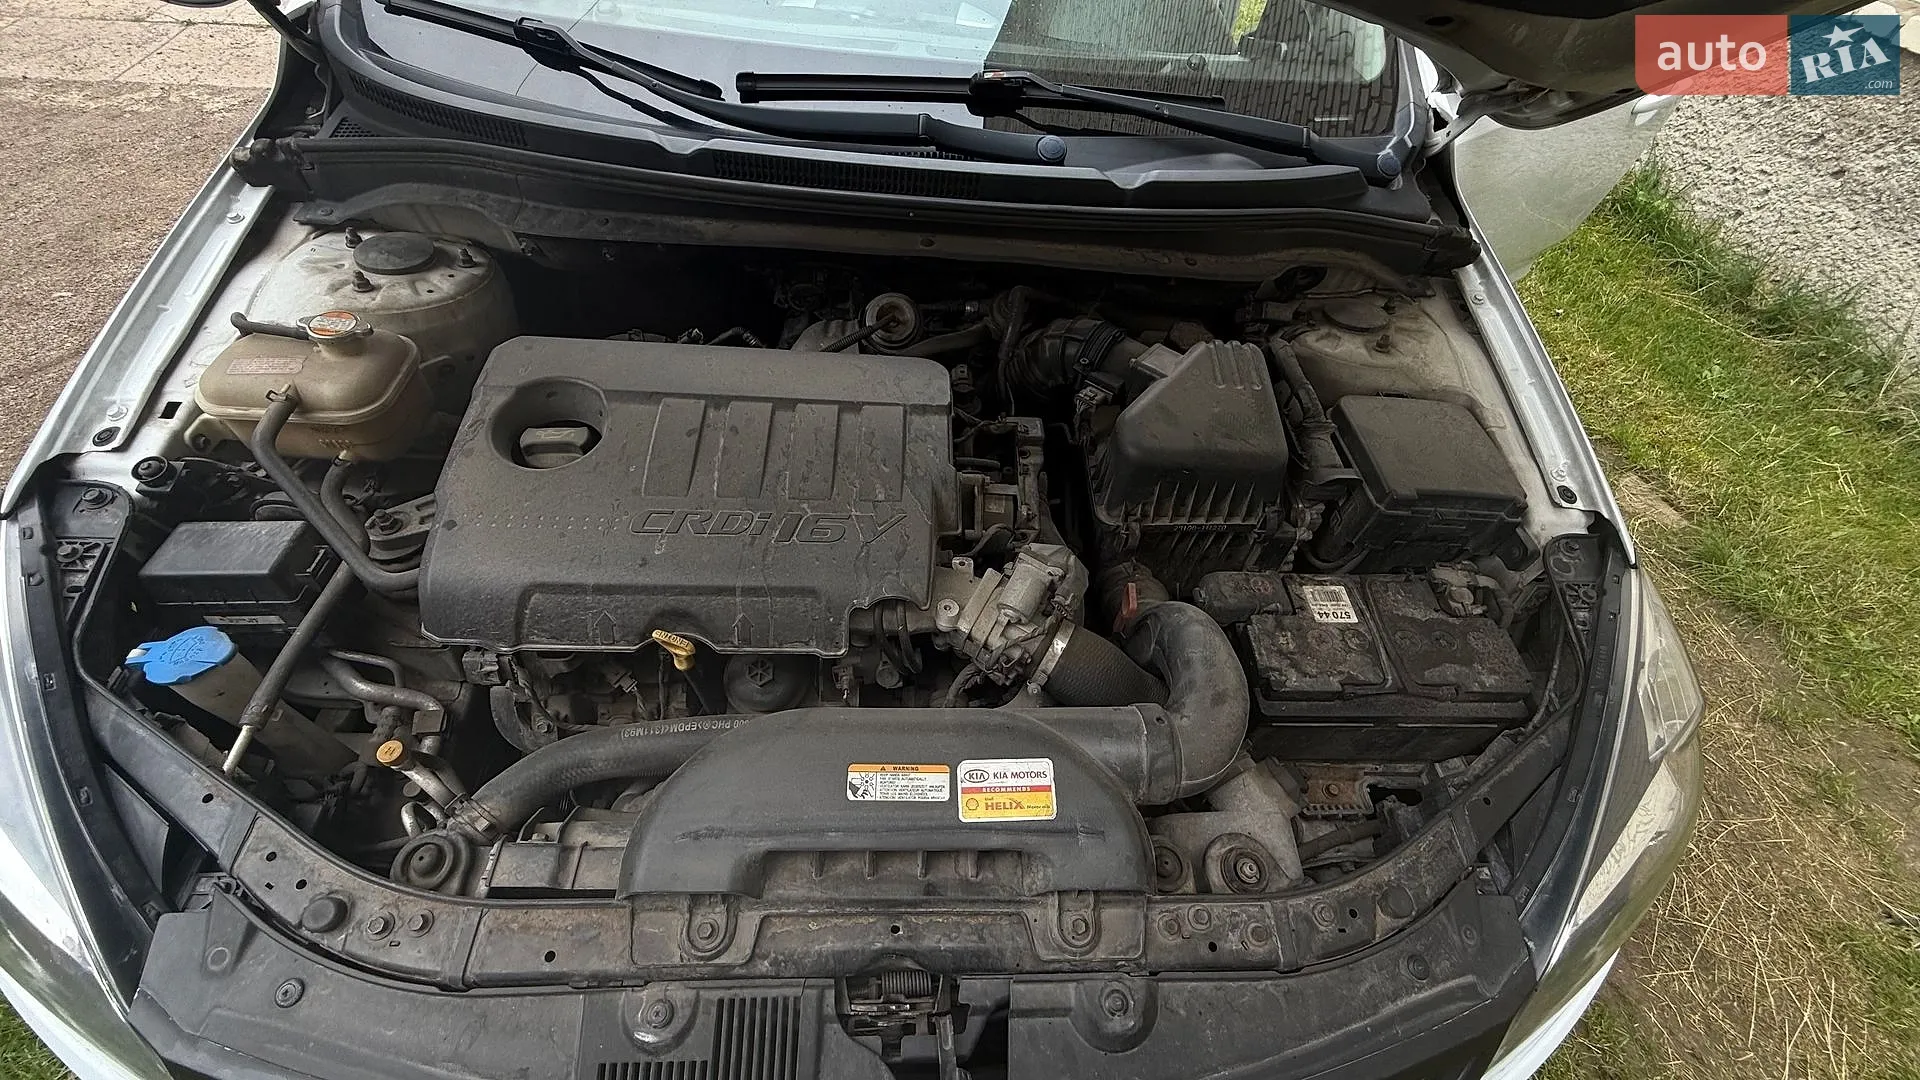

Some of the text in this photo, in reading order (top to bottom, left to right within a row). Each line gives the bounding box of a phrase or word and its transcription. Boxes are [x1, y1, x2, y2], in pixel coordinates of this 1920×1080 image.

[1317, 611, 1351, 620] 570 44
[993, 770, 1048, 780] KIA MOTORS
[985, 799, 1026, 811] HELIX
